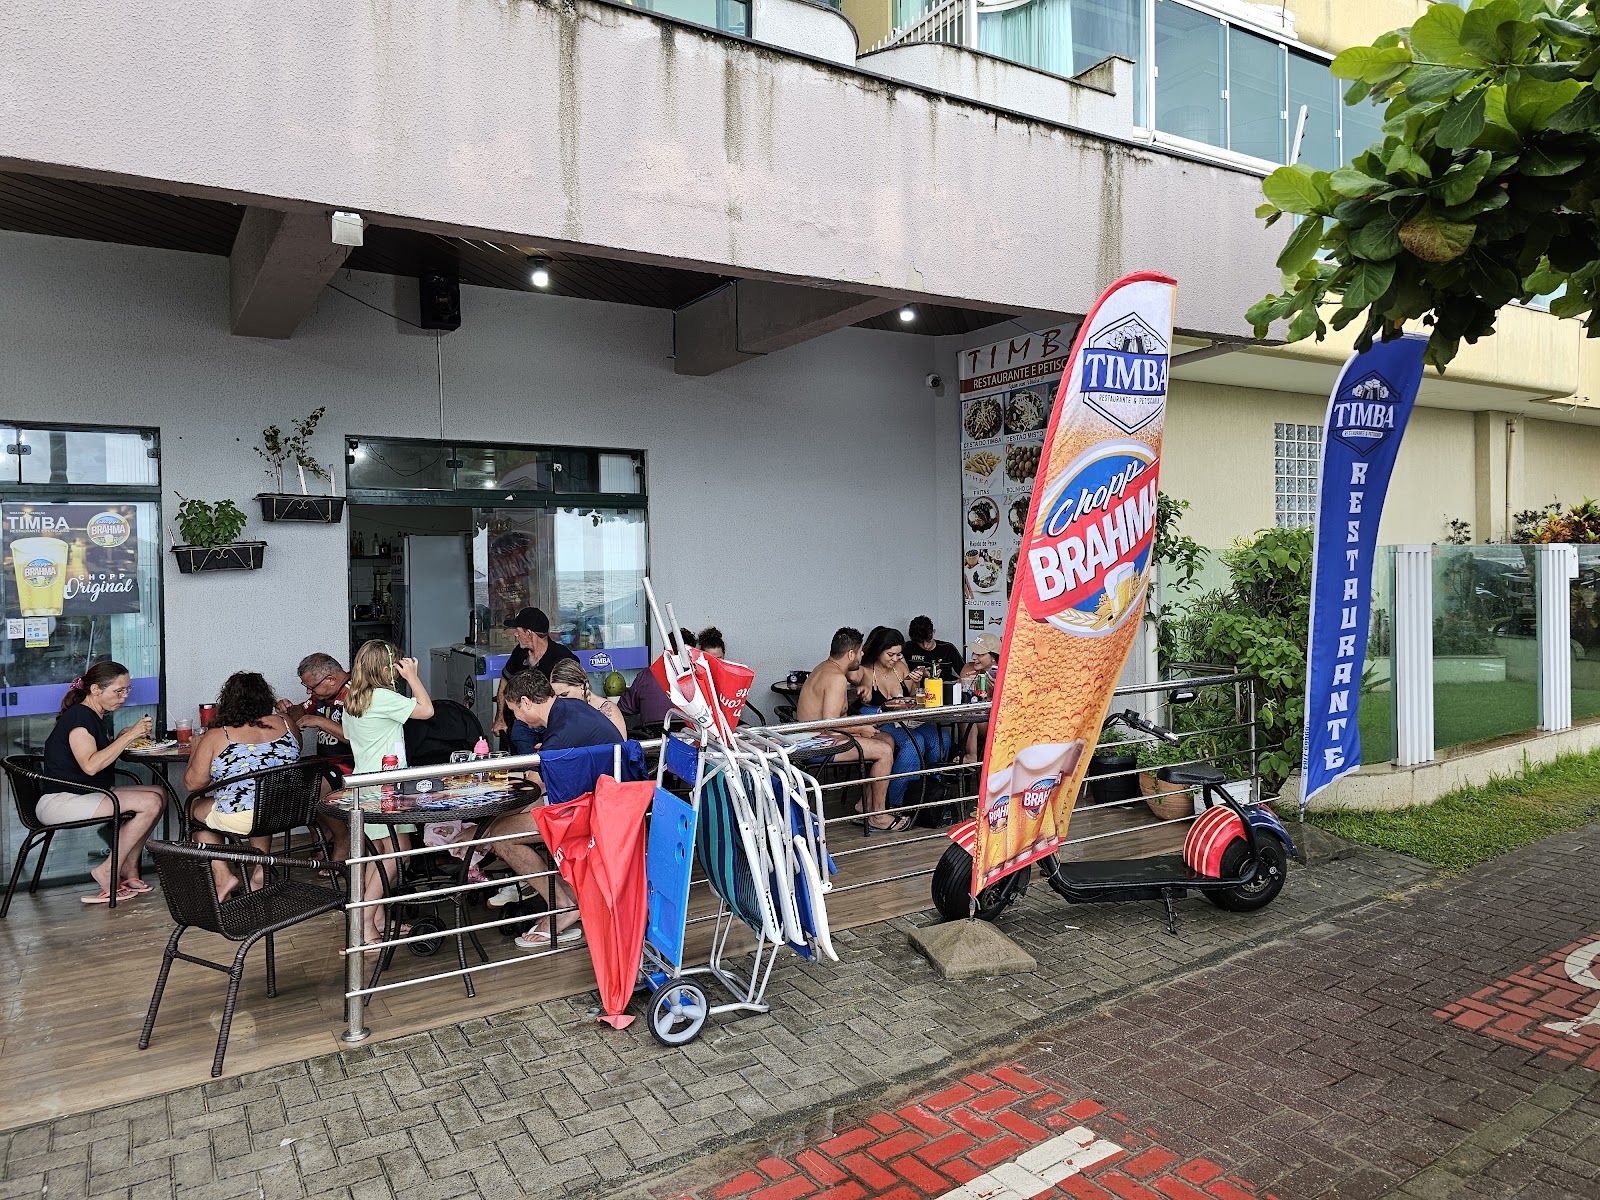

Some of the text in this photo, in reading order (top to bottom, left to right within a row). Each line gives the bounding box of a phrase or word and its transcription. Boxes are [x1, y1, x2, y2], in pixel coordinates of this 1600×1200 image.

[973, 368, 1030, 389] RESTAURANTE
[1031, 366, 1037, 376] E
[1038, 359, 1067, 373] PETISC
[1085, 354, 1167, 392] TIMBA
[1099, 394, 1131, 403] RESTAURANTE
[1334, 402, 1394, 428] TIMBA
[1048, 460, 1145, 537] Chopp
[7, 516, 70, 530] TIMBA
[91, 525, 126, 535] BRAHMA
[24, 567, 57, 577] BRAHMA
[63, 578, 133, 602] Original
[1323, 462, 1369, 771] RESTAURANTE
[590, 657, 611, 665] TIMBA
[989, 805, 1008, 825] BRAH
